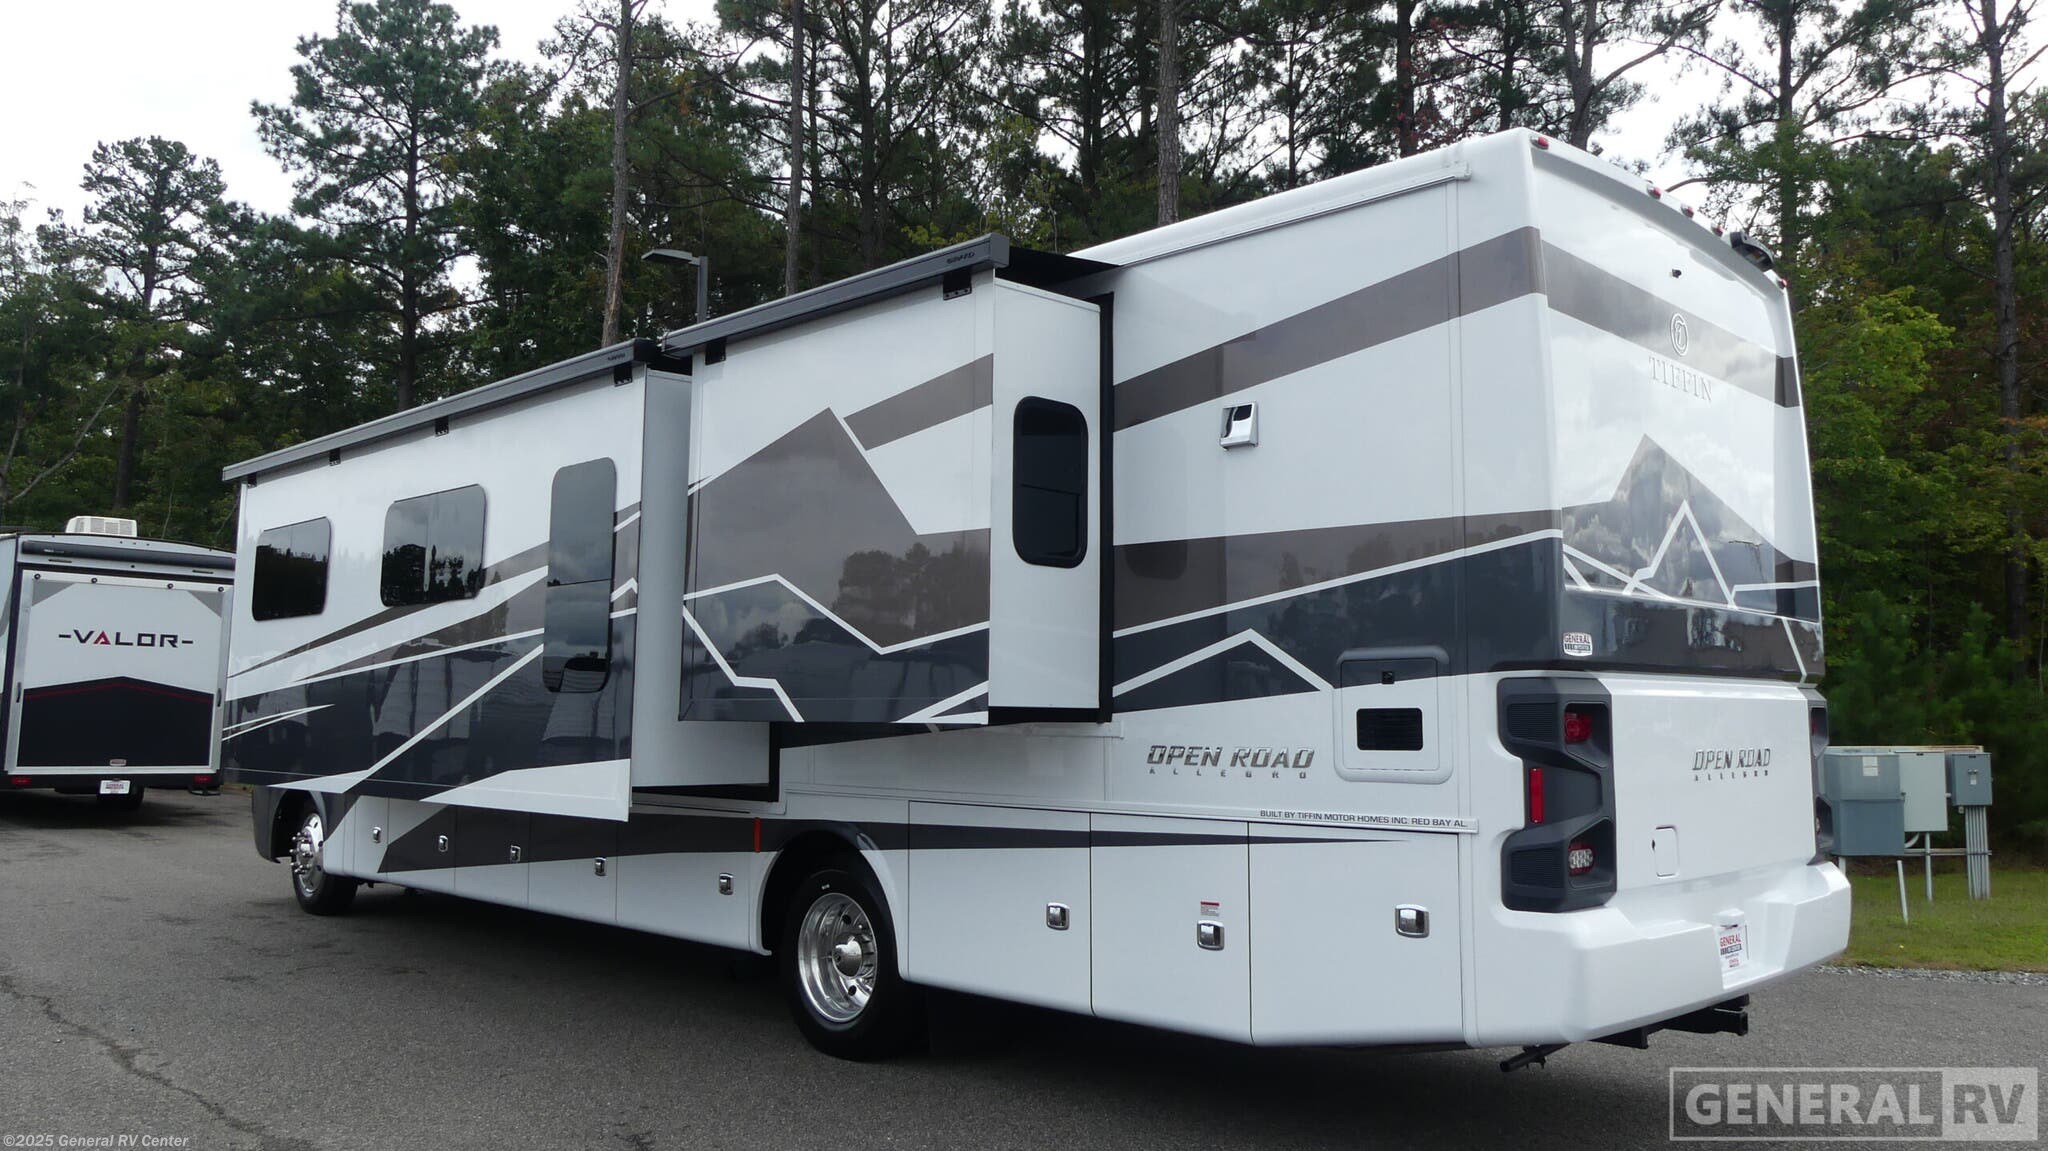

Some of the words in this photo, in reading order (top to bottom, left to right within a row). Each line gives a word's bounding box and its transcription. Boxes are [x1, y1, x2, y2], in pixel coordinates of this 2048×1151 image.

[1648, 355, 1712, 402] TIFFIN
[1147, 745, 1223, 767] OPEN
[1230, 745, 1315, 769] ROAD
[1692, 750, 1733, 771] OPEN
[1737, 748, 1771, 769] ROAD
[1260, 809, 1282, 818] BUILT
[1284, 811, 1296, 819] BY
[1297, 811, 1322, 820] TIFFIN
[1324, 813, 1355, 822] MOTOR
[1357, 815, 1389, 824] HOMES
[1411, 817, 1430, 826] RED
[1432, 818, 1452, 827] BAY
